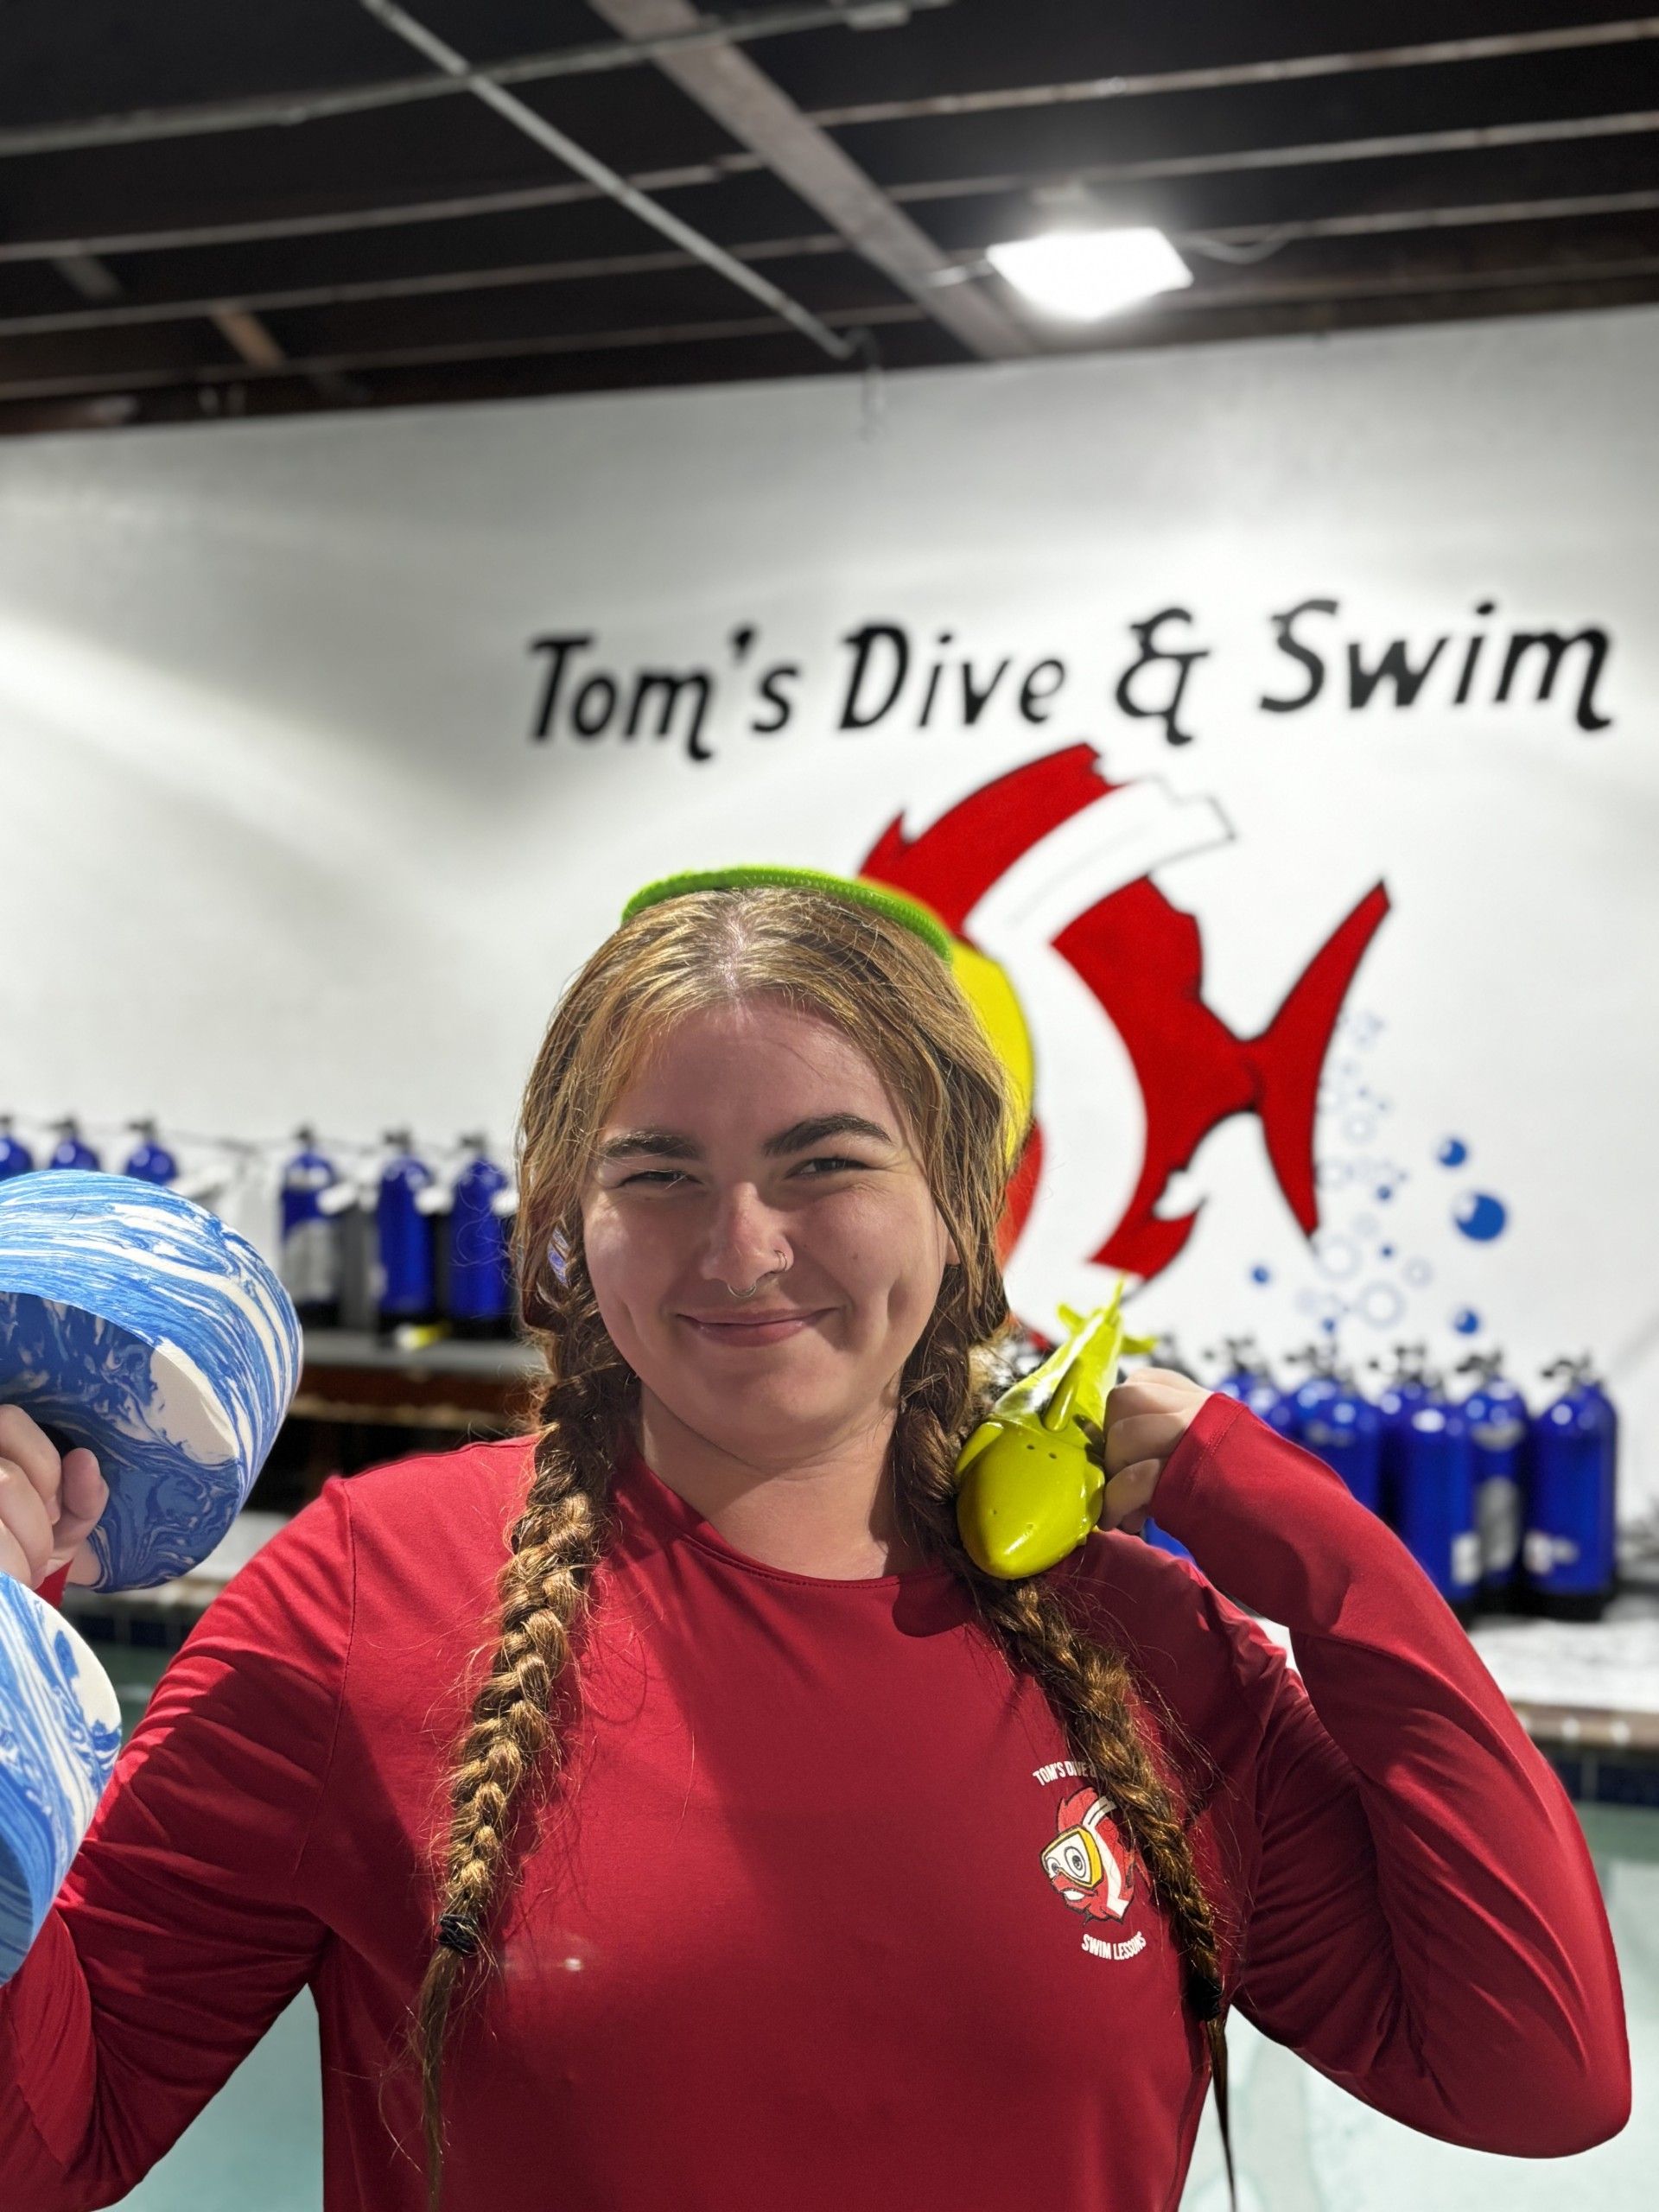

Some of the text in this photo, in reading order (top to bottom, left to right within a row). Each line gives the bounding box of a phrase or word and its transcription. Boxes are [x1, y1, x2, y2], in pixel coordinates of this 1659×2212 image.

[528, 598, 1612, 761] Tom's Dive & Swim
[1033, 1761, 1065, 1785] TOM'S
[1082, 1931, 1147, 1960] SWIM LESSONS
